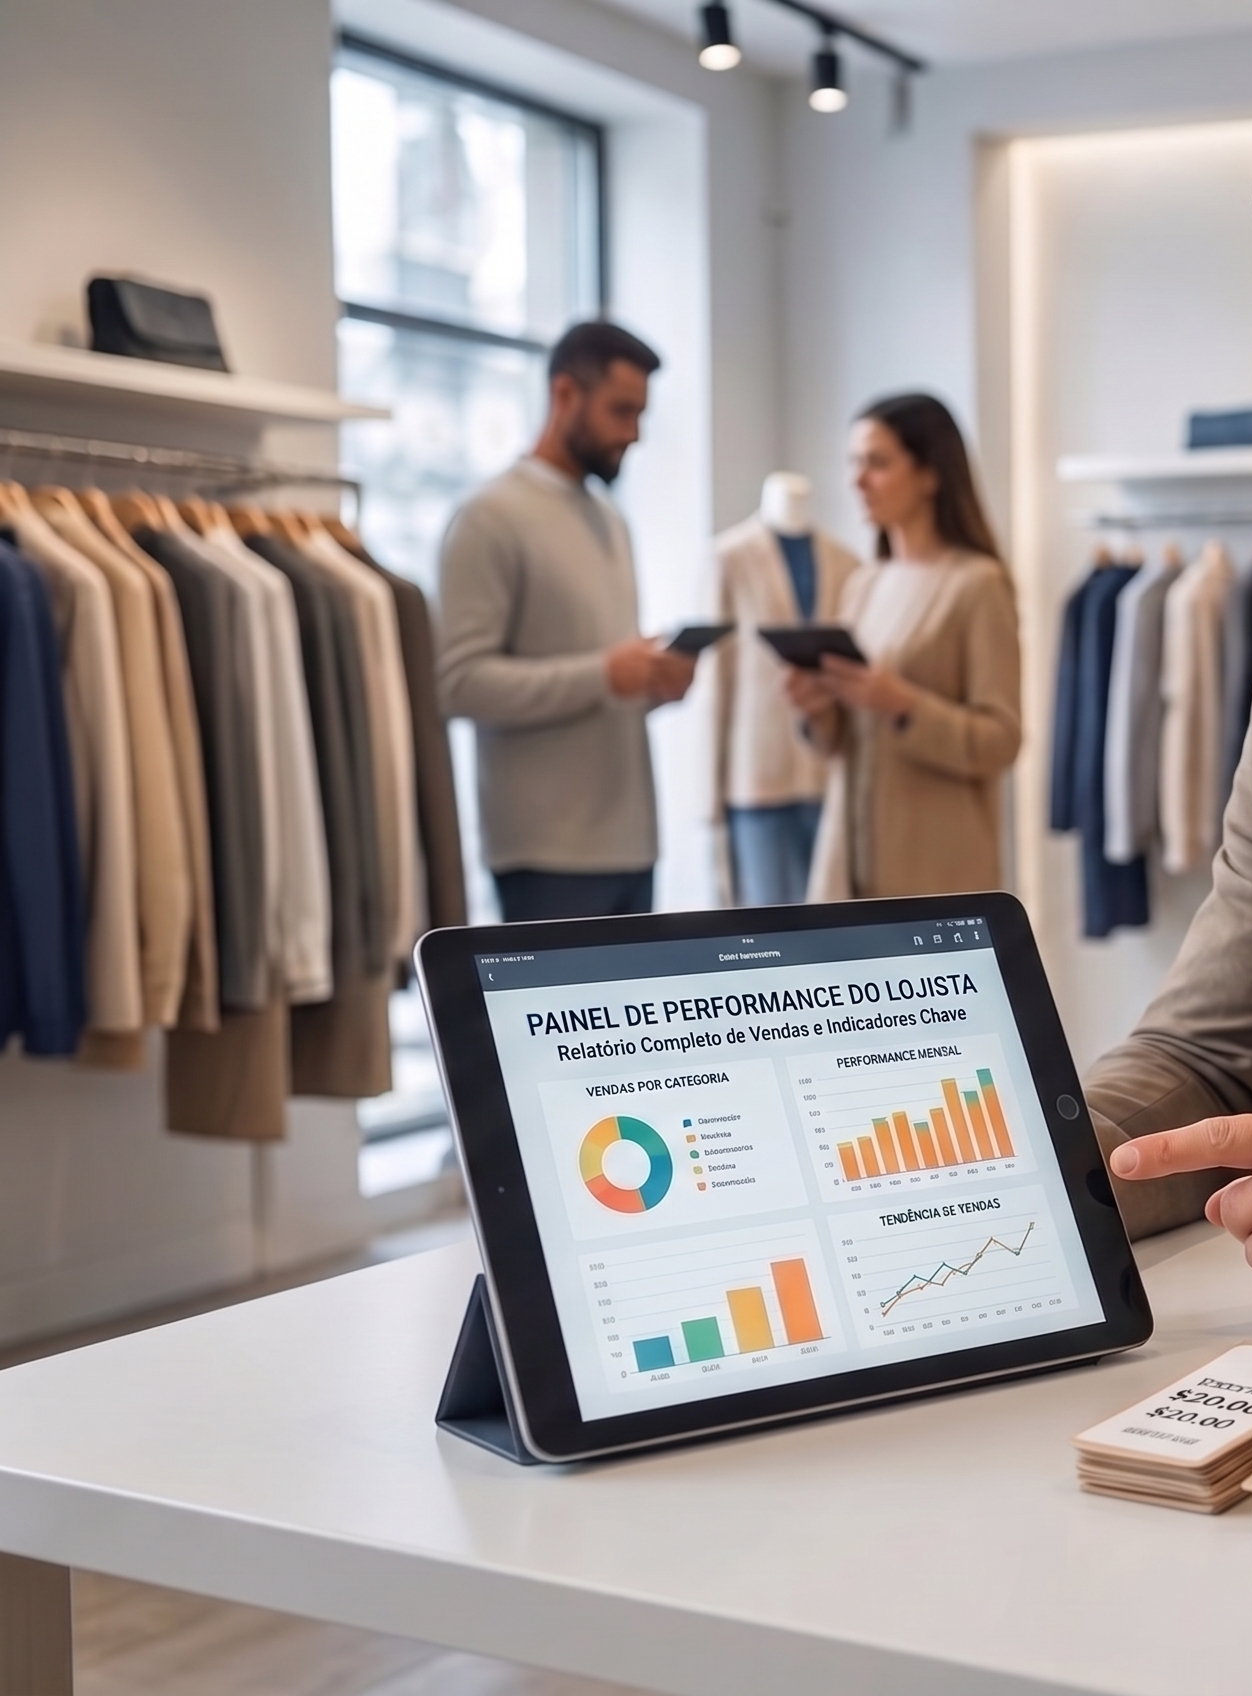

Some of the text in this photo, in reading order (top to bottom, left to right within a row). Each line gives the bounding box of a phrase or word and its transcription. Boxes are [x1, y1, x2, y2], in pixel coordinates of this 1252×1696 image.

[526, 974, 978, 1036] PAINEL DE PERFORMANCE DO LOJISTA
[557, 1007, 967, 1062] Relatório Completo de Vendas e Indicadores Chave
[836, 1045, 962, 1068] PERFORMANCE MENSAL
[586, 1072, 730, 1097] VENDAS POR CATEGORIA
[879, 1209, 941, 1227] TENDÊNCIA
[1146, 1406, 1236, 1430] $20.00
